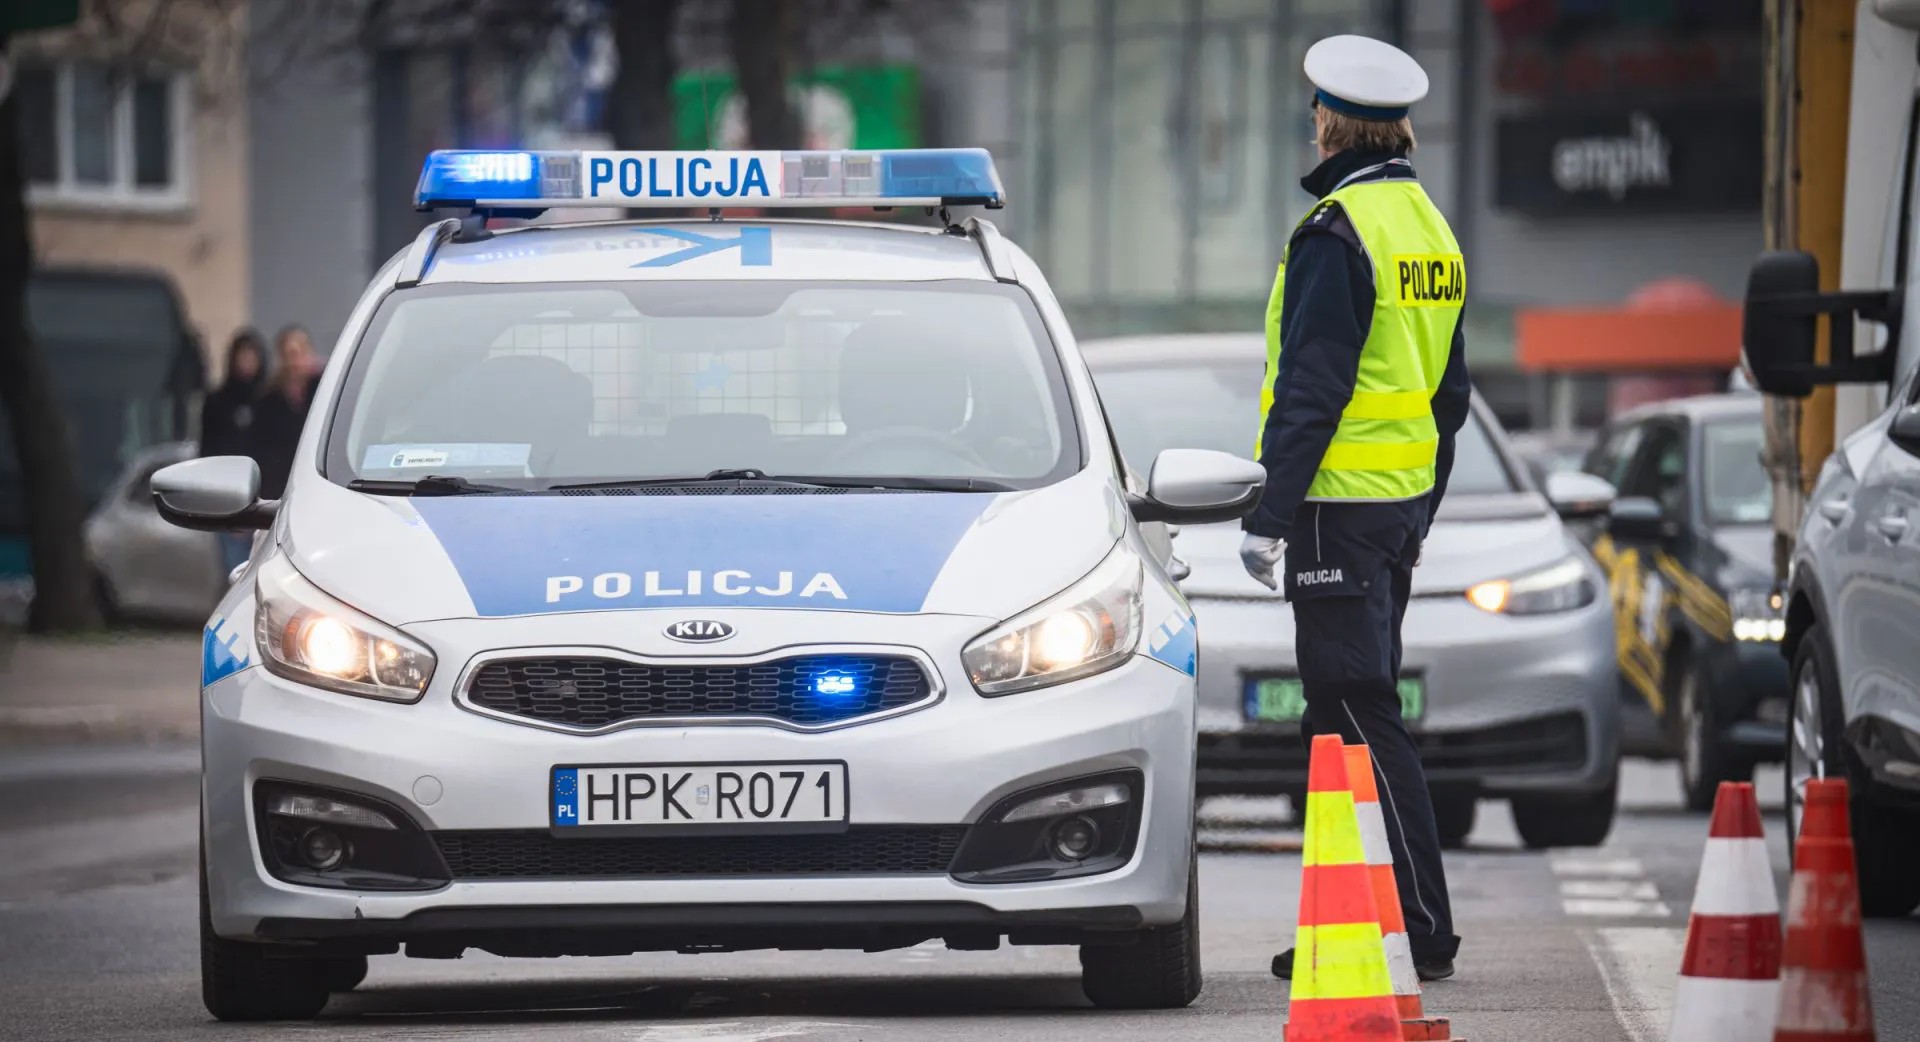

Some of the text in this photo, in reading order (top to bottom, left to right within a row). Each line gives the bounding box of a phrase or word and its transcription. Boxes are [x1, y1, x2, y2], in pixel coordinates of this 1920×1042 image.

[1553, 111, 1671, 199] empik
[590, 157, 771, 197] POLICJA
[1398, 259, 1463, 301] POLICJA
[545, 569, 848, 603] POLICJA
[1297, 568, 1343, 587] POLICJA
[675, 622, 726, 638] KIA
[558, 805, 575, 818] PL
[587, 771, 831, 821] HPK R071
